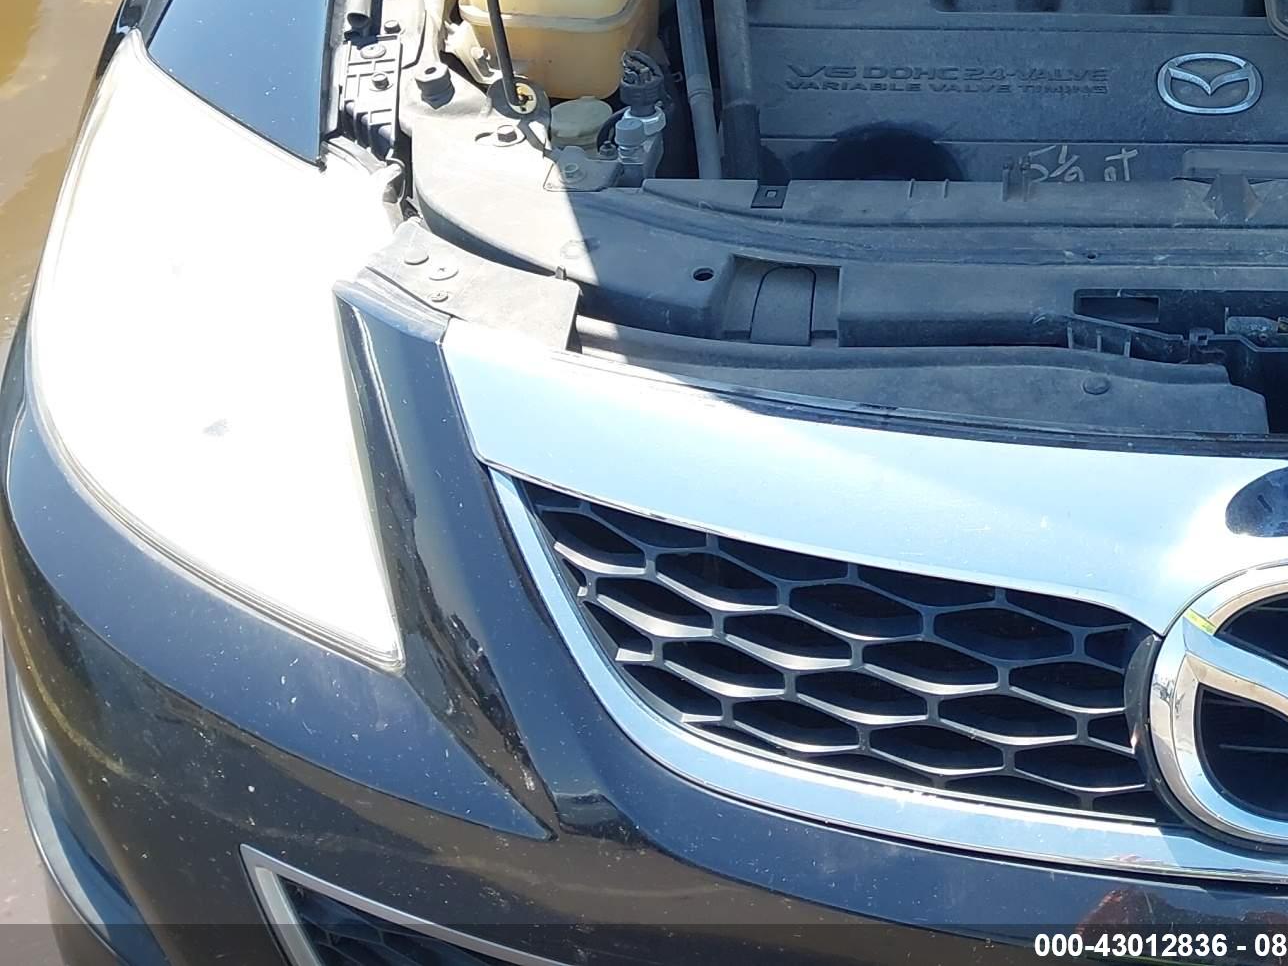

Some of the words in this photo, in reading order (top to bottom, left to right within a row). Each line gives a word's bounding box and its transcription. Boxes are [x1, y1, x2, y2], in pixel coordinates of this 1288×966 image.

[787, 64, 857, 79] V6
[861, 66, 959, 81] DOHC
[963, 67, 1109, 82] 24-VALVE
[785, 81, 922, 92] VARIABLE
[928, 83, 1012, 94] VALVE
[1017, 84, 1108, 95] TIMING
